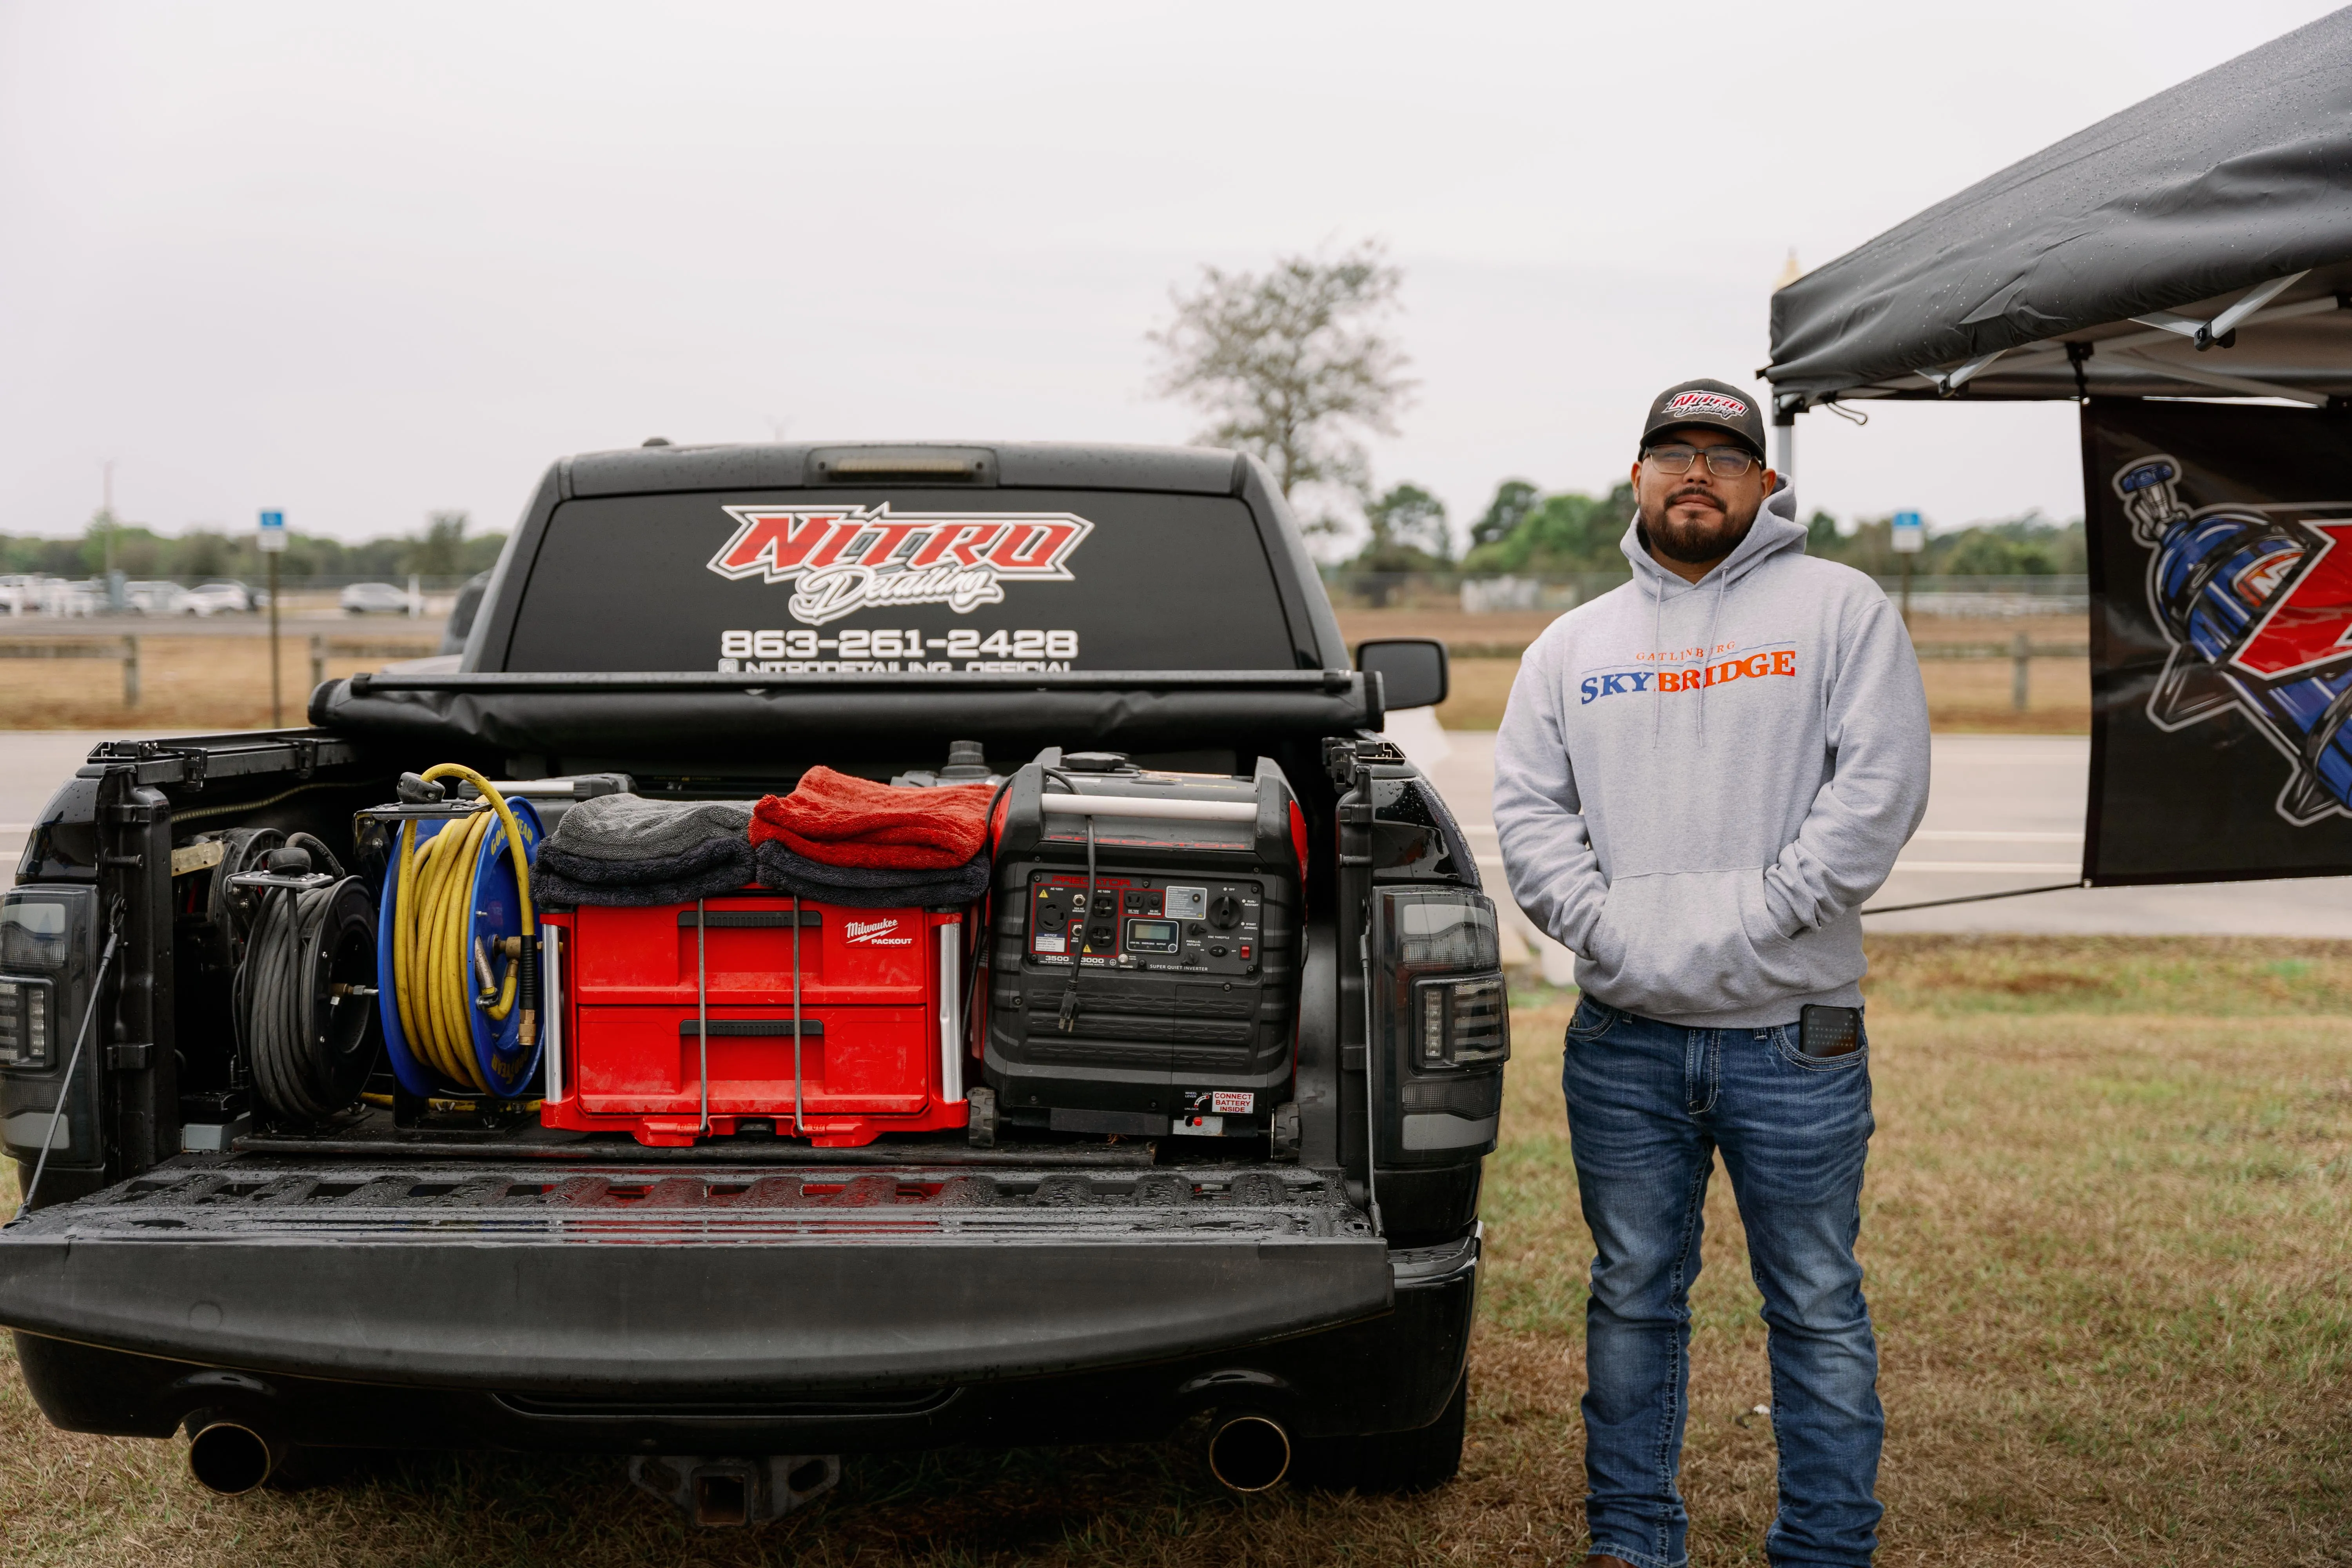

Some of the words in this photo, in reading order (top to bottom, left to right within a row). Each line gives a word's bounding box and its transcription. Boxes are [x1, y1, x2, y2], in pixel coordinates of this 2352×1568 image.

[1669, 393, 1746, 414] NITRO
[720, 512, 1076, 571] NITRO
[794, 564, 992, 619] Detailing
[720, 629, 1079, 659] 863-261-2428
[844, 918, 898, 938] Milwaukee
